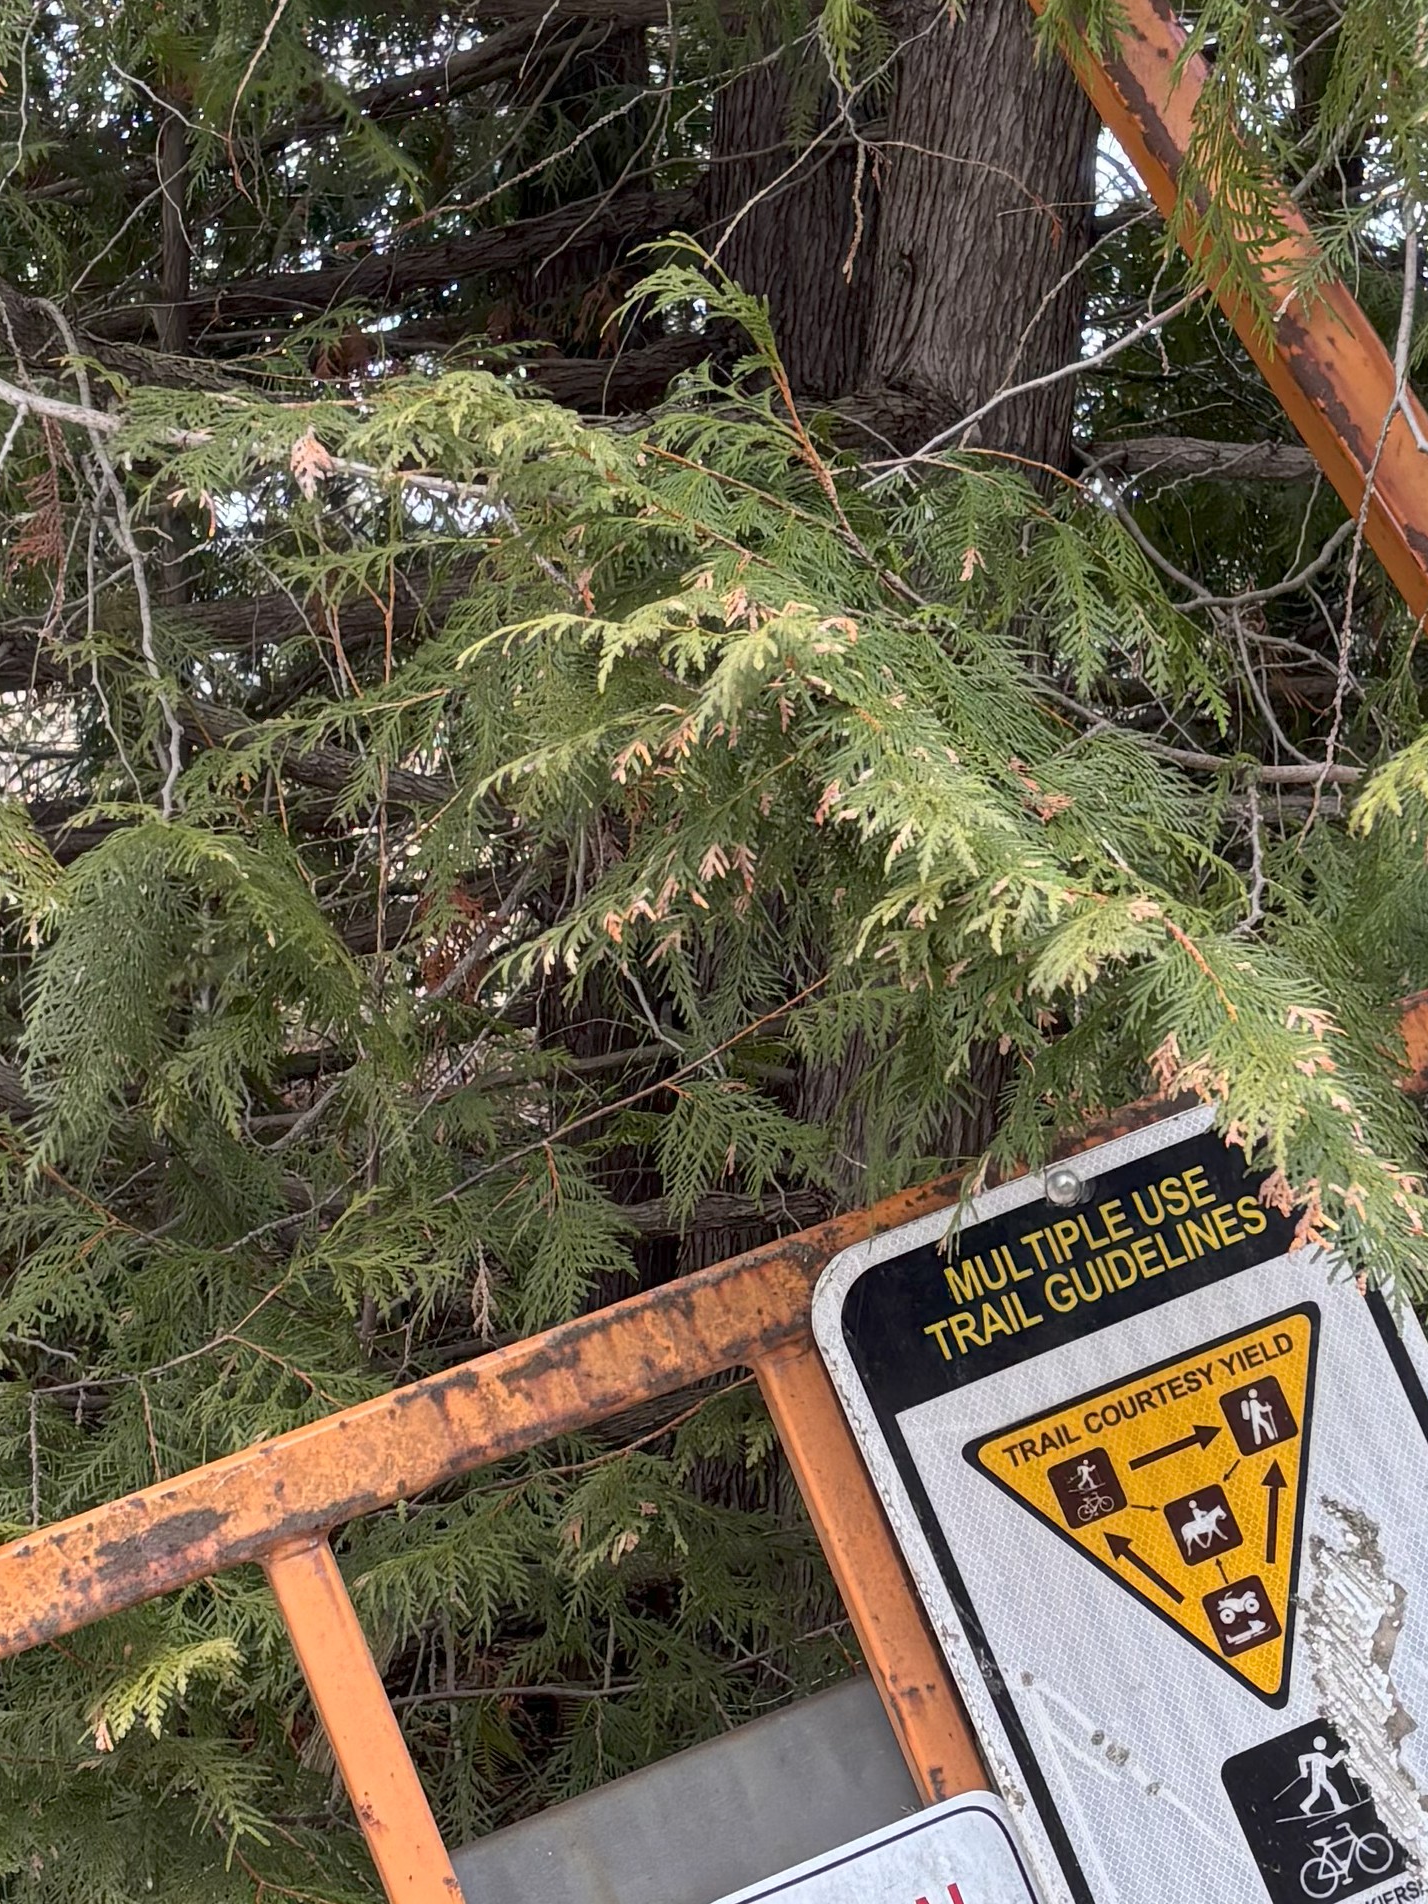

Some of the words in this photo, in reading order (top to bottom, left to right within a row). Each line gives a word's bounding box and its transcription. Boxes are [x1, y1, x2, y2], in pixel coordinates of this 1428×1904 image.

[923, 1293, 1042, 1360] TRAIL
[1043, 1196, 1266, 1312] GUIDELINES
[943, 1200, 1132, 1304] MULTIPLE
[1130, 1166, 1215, 1226] USE
[1000, 1423, 1082, 1467] TRAIL
[1082, 1361, 1214, 1434] COURTESY
[1216, 1332, 1294, 1376] YIELD
